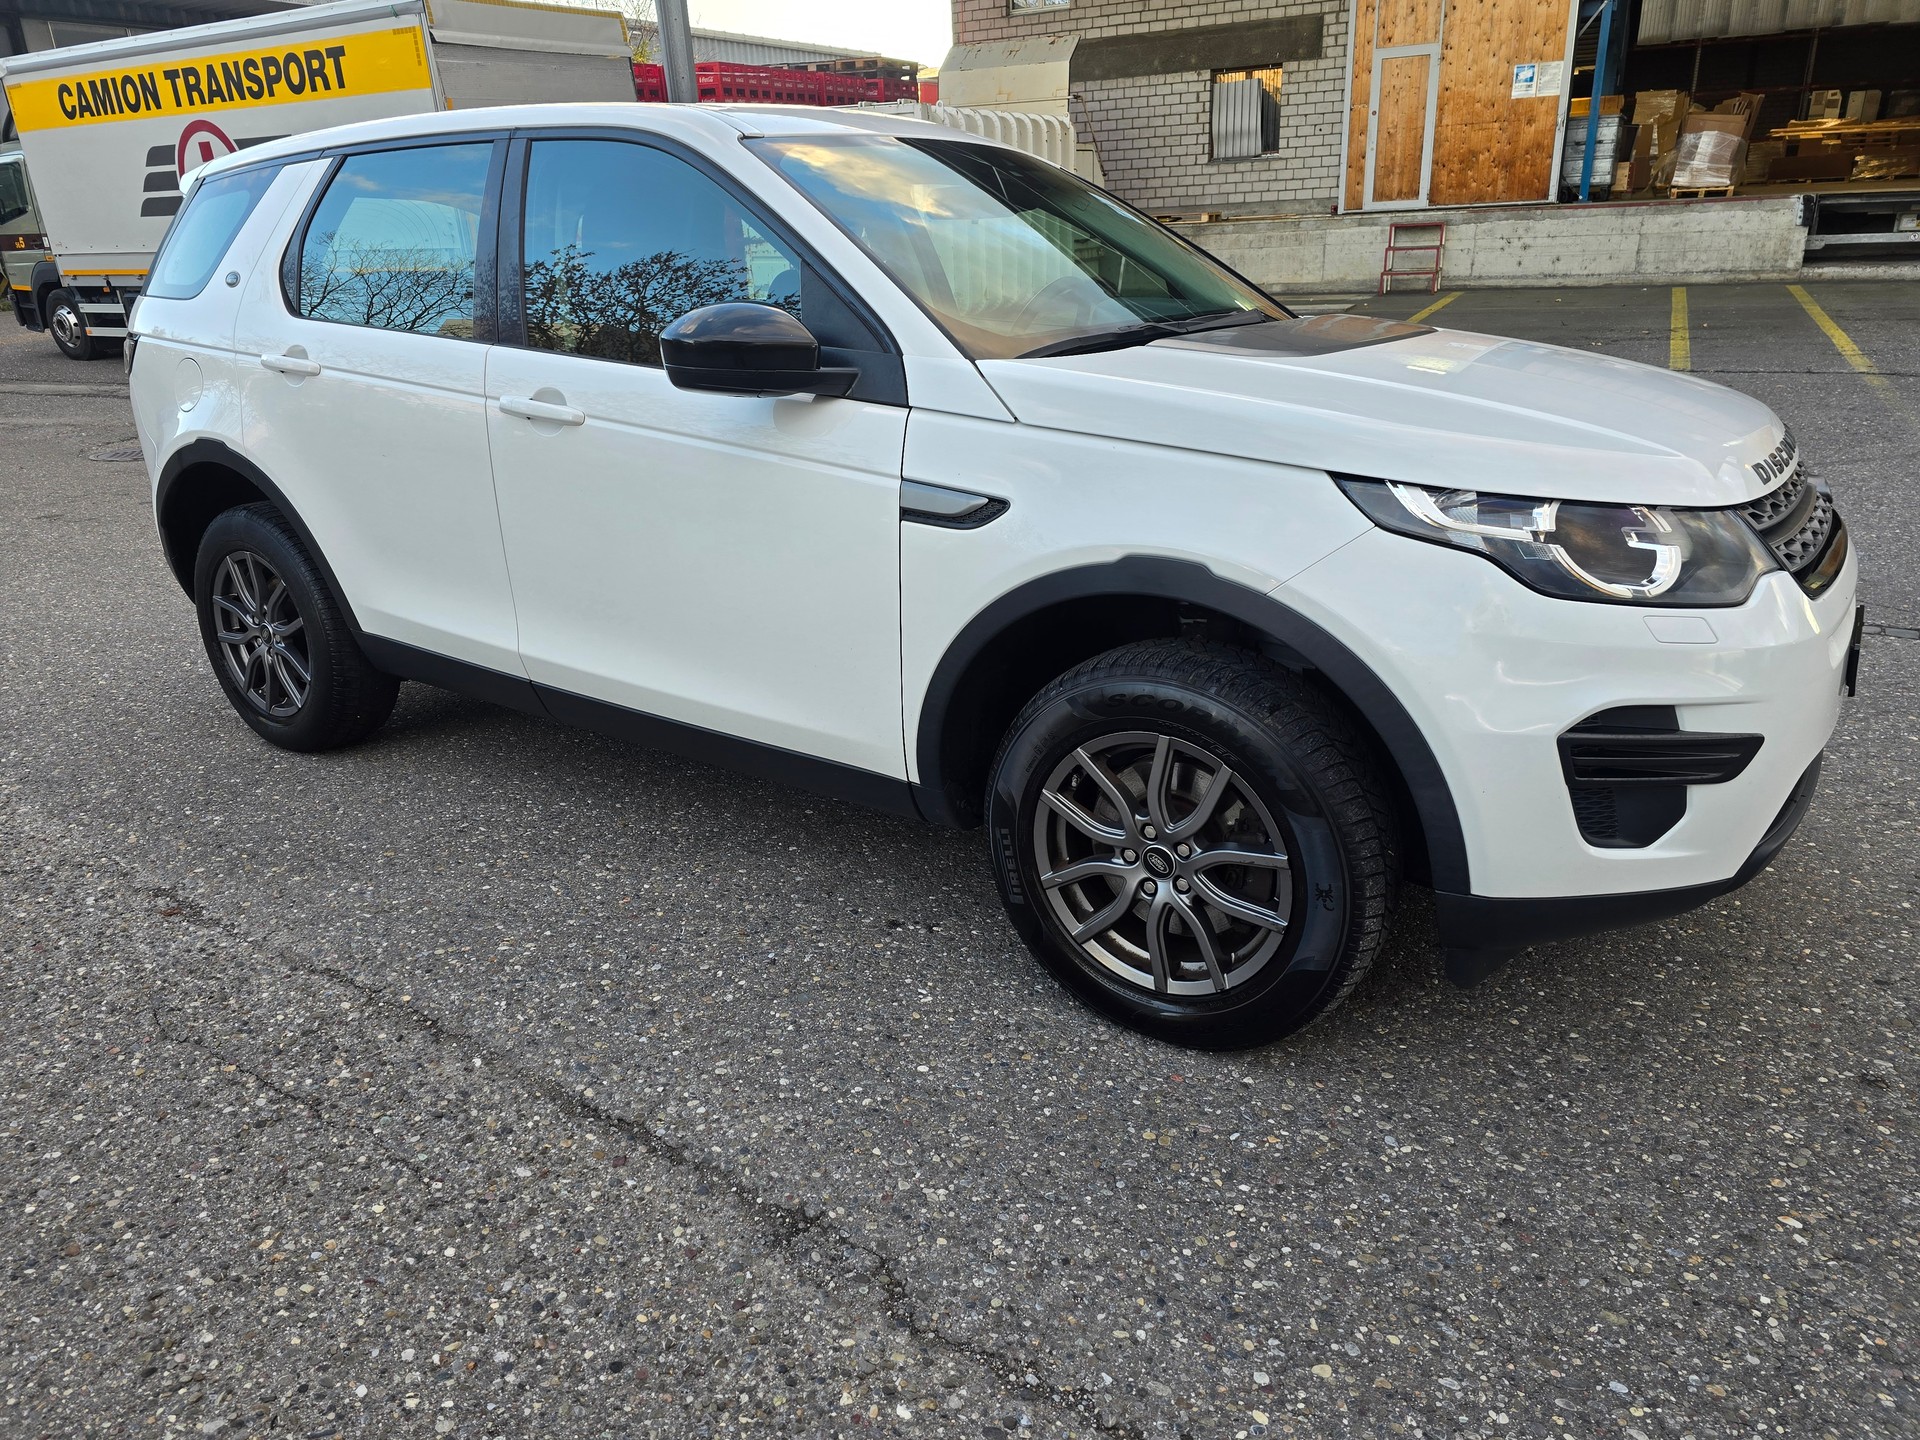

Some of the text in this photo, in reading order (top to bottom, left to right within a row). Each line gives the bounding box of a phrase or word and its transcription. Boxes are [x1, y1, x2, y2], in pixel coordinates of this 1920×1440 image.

[57, 45, 346, 120] CAMION TRANSPORT
[995, 827, 1024, 905] PIRELLI
